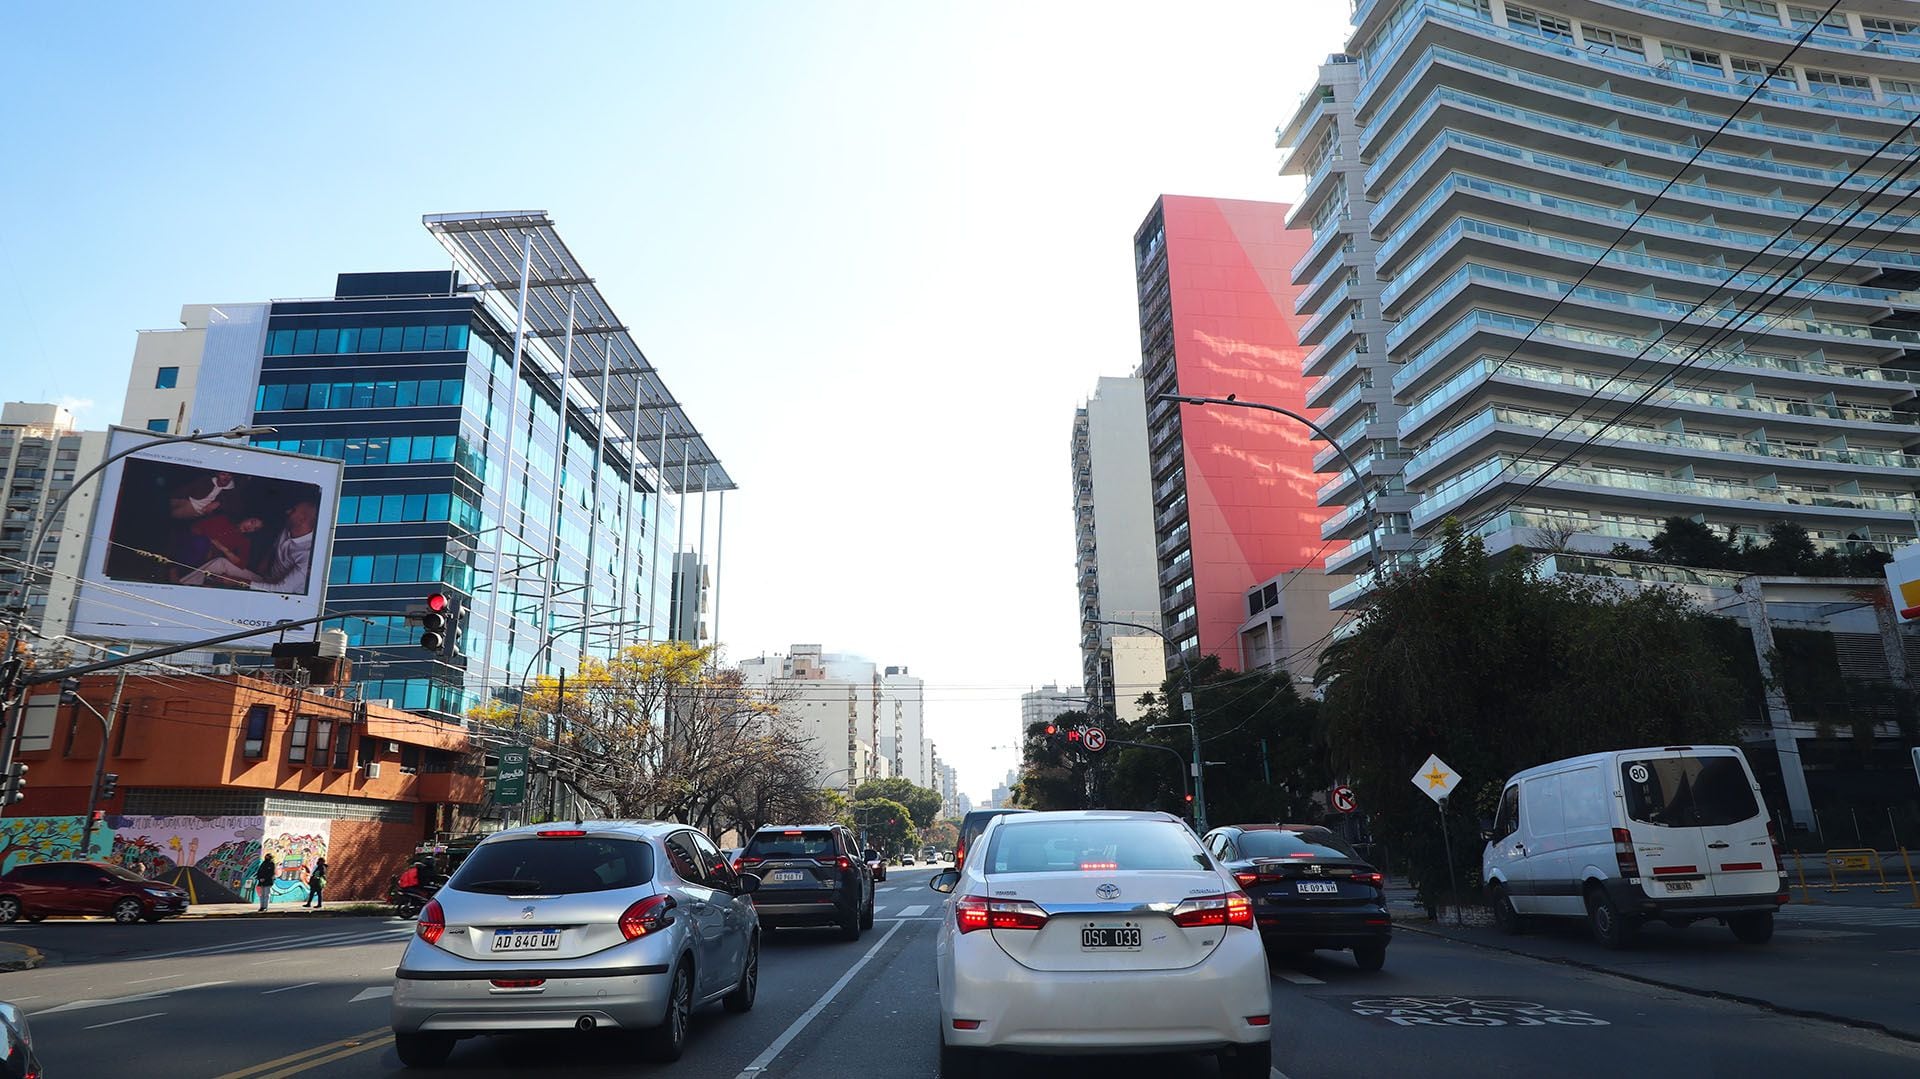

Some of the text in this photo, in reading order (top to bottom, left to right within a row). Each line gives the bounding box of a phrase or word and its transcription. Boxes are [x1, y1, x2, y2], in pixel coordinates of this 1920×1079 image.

[231, 618, 273, 627] LACOSTE
[1069, 731, 1080, 741] 14
[1632, 768, 1646, 779] 80
[1300, 884, 1336, 892] AE 091 VH
[495, 936, 511, 949] AD
[515, 934, 538, 948] 840
[1083, 930, 1140, 946] OSC 033
[1352, 1008, 1593, 1016] PARA EN
[1384, 1016, 1612, 1026] ROJO
